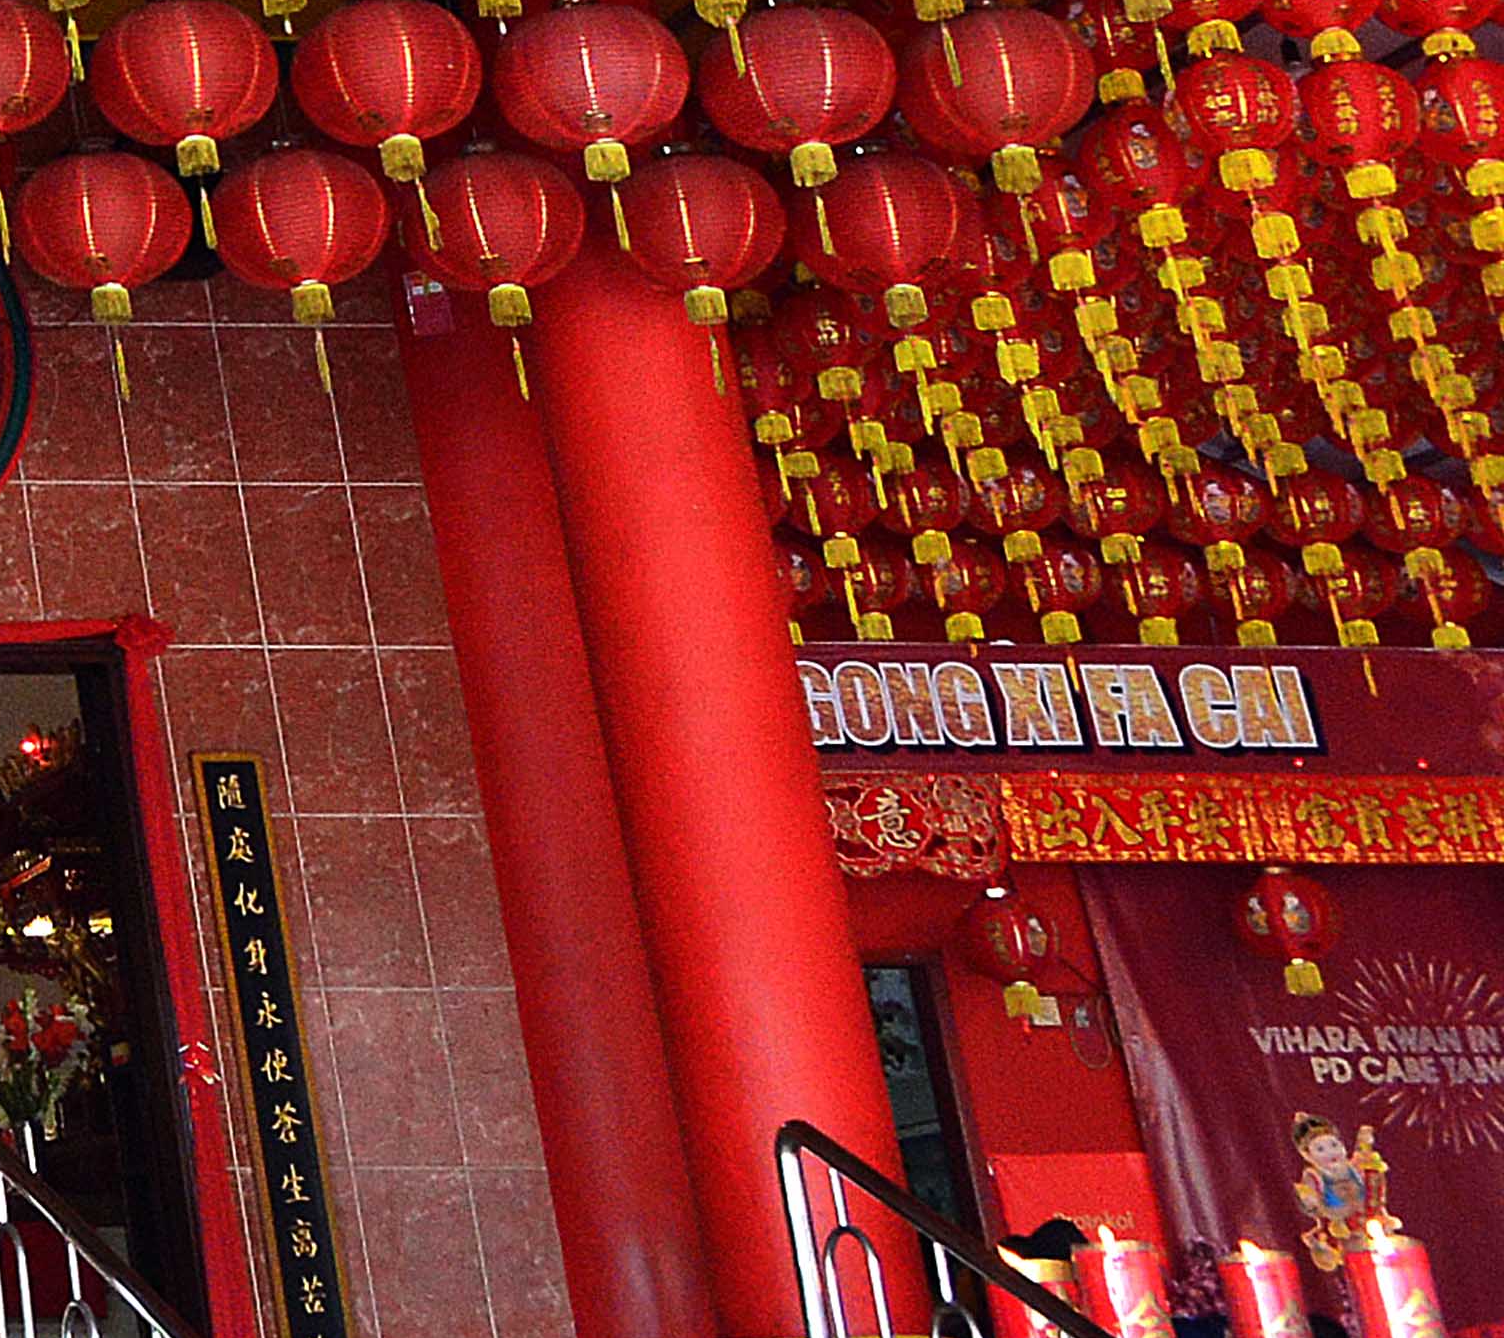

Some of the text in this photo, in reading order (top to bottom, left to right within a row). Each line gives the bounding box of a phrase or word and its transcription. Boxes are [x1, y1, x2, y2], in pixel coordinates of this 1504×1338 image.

[796, 660, 1319, 749] GONG XI FA CAI
[1248, 1025, 1501, 1054] VIHARA KWAN IN
[1310, 1056, 1353, 1084] PD
[1359, 1056, 1439, 1085] CABE
